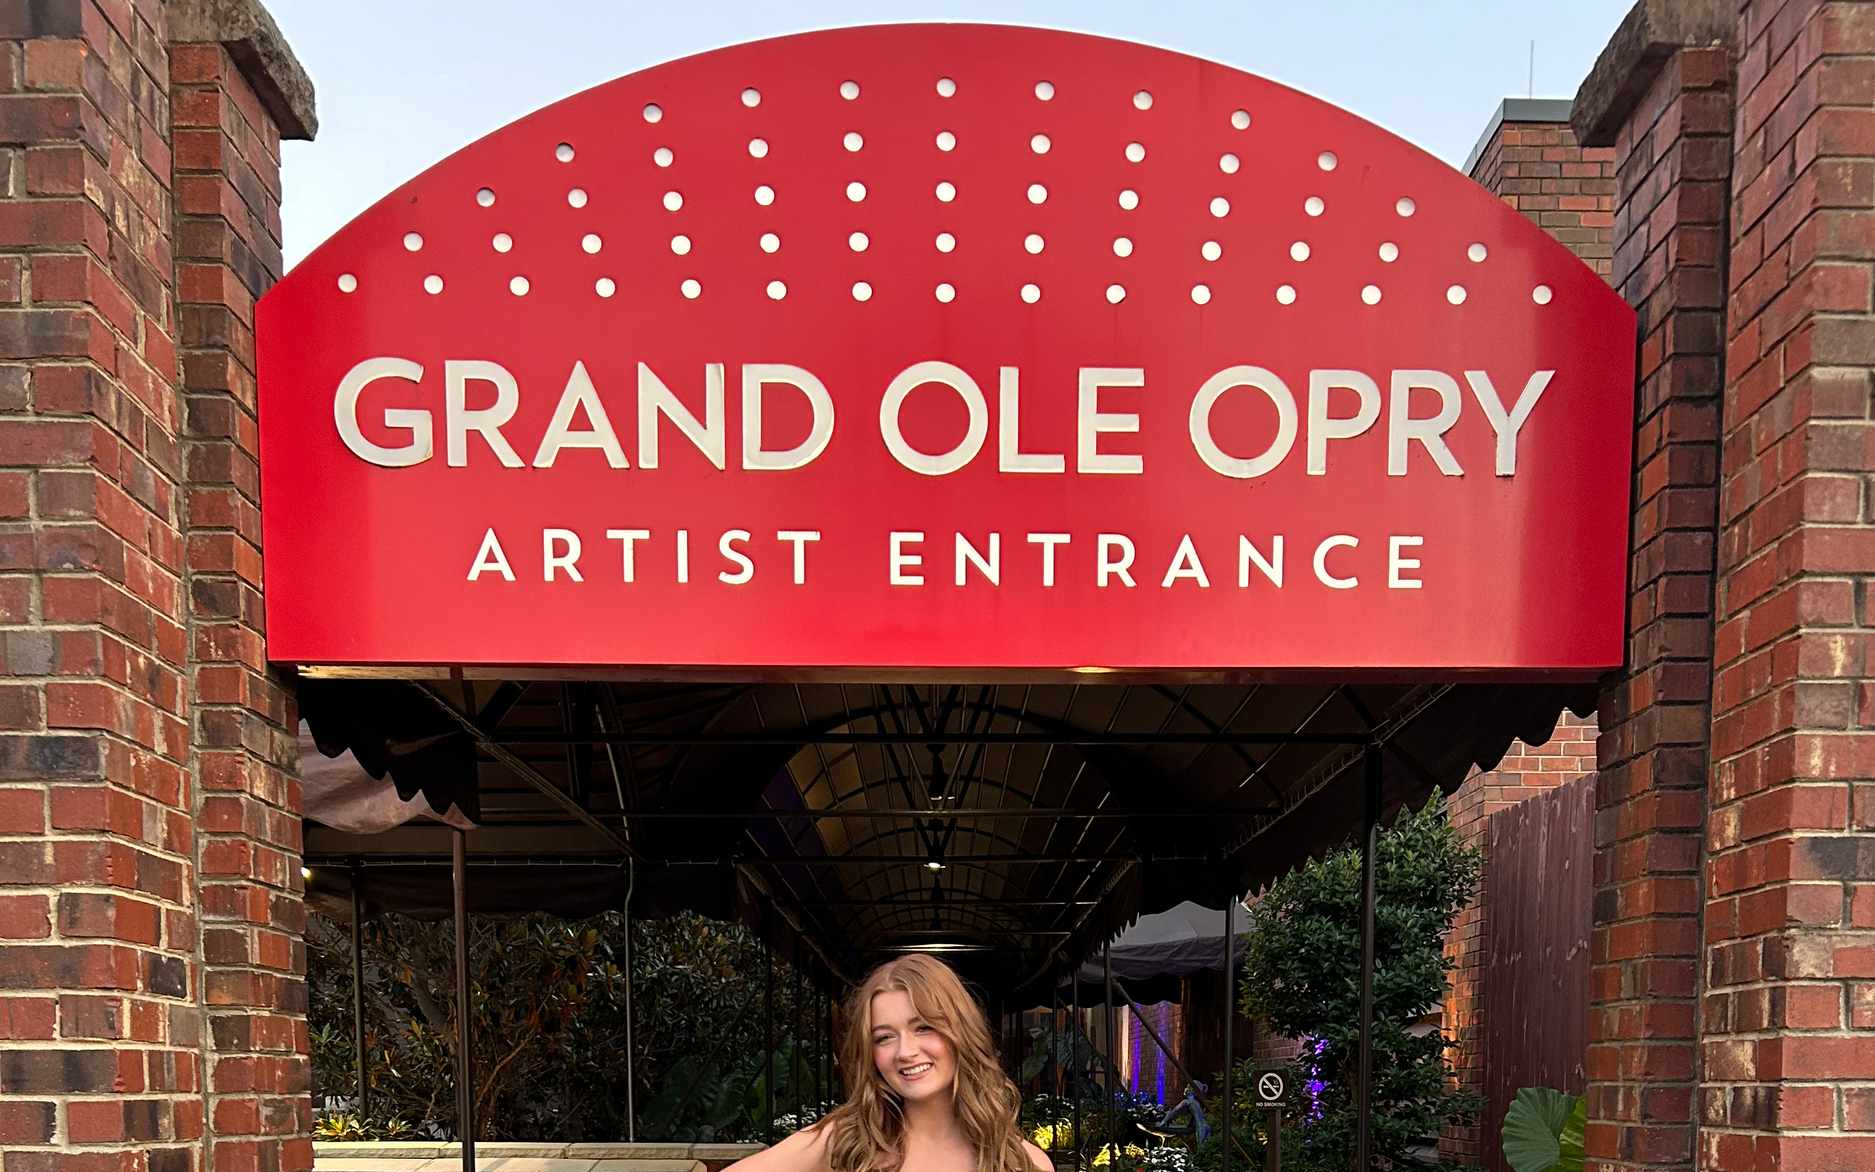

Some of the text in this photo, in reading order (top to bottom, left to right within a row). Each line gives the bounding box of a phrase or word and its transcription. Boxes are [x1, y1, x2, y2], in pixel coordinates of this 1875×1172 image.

[333, 356, 1556, 479] GRAND OLE OPRY
[466, 527, 1424, 590] ARTIST ENTRANCE
